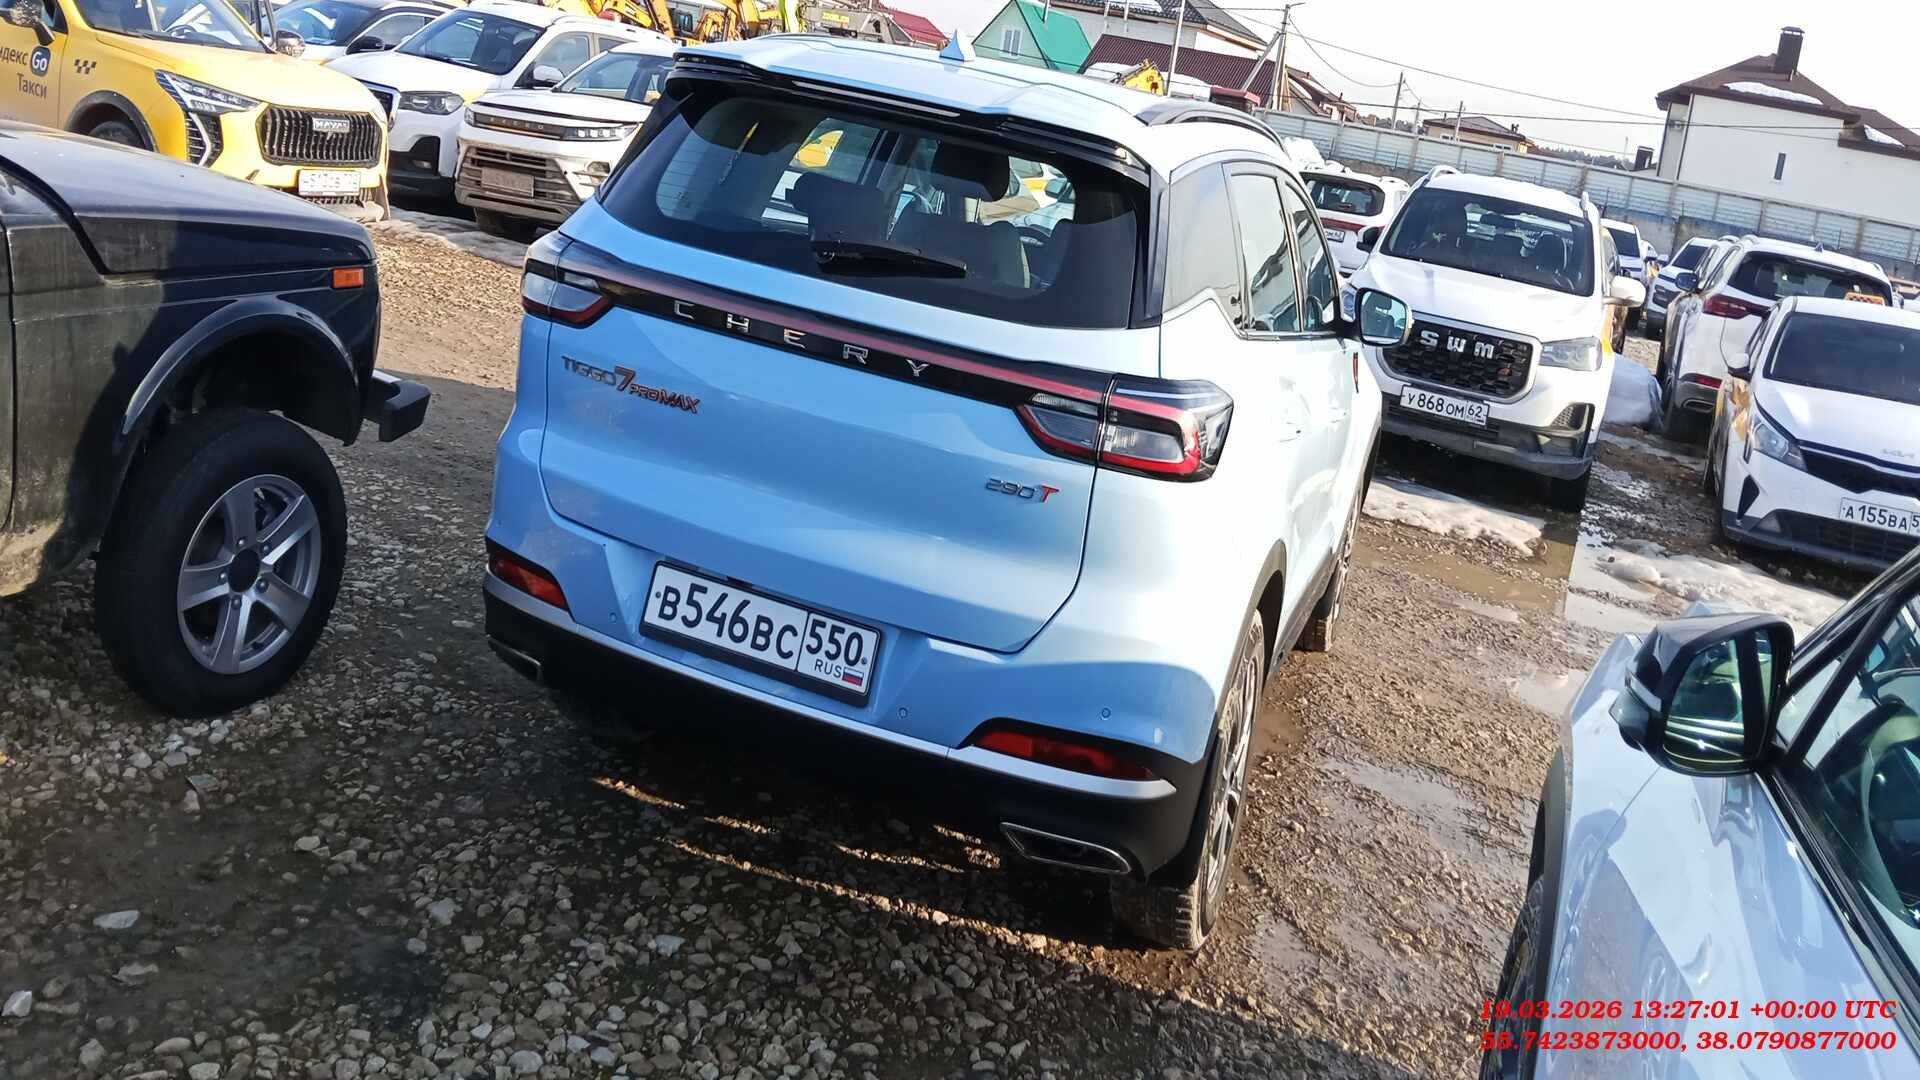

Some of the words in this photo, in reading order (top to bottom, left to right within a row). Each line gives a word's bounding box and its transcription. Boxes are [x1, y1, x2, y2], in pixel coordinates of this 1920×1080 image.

[32, 51, 48, 71] Go
[16, 73, 47, 99] Такси
[674, 300, 928, 377] CHERY
[1421, 329, 1495, 360] SWM
[657, 582, 798, 660] В546ВС
[806, 618, 864, 667] 550
[814, 658, 842, 679] RUS
